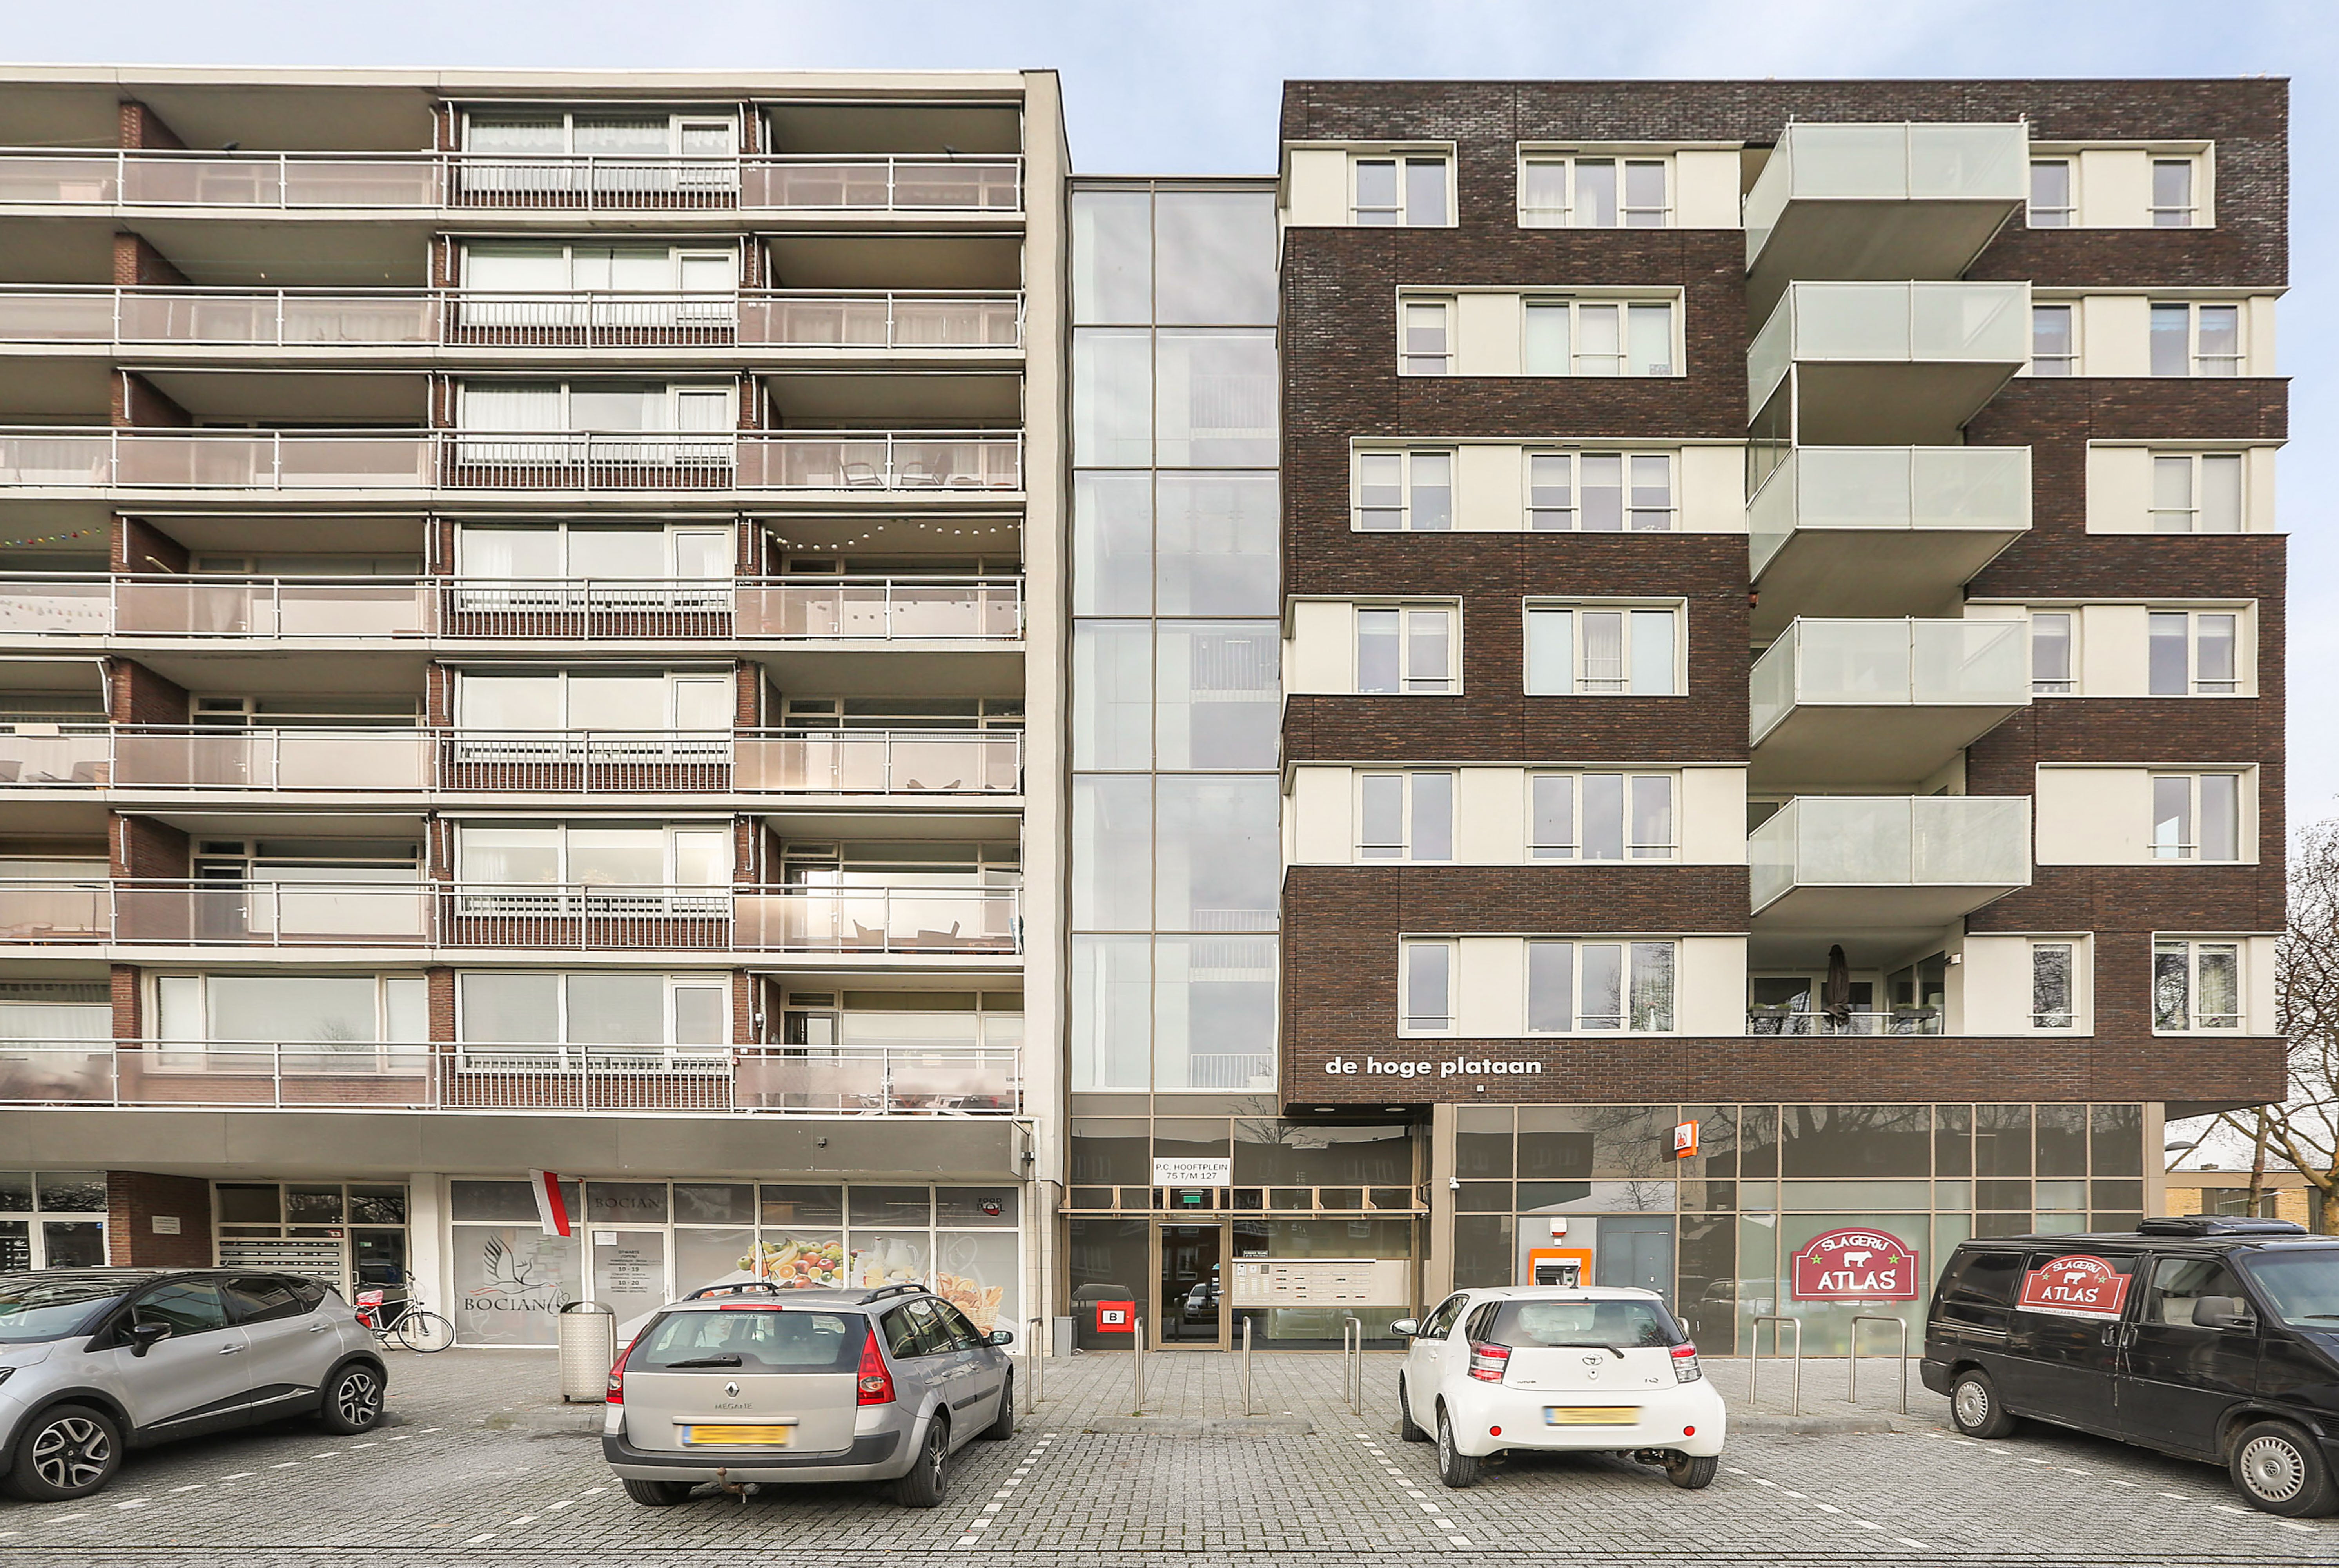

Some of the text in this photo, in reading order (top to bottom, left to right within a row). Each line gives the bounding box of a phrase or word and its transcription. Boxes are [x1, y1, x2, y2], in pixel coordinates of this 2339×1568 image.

[1325, 1056, 1542, 1078] de hoge plataan
[595, 1198, 660, 1208] BOCIAN
[1821, 1235, 1889, 1251] SLAGERIJ
[2052, 1261, 2102, 1274] SLAGERIJ
[1817, 1269, 1897, 1290] ATLAS
[2041, 1286, 2099, 1303] ATLAS
[465, 1298, 546, 1311] BOCIAN
